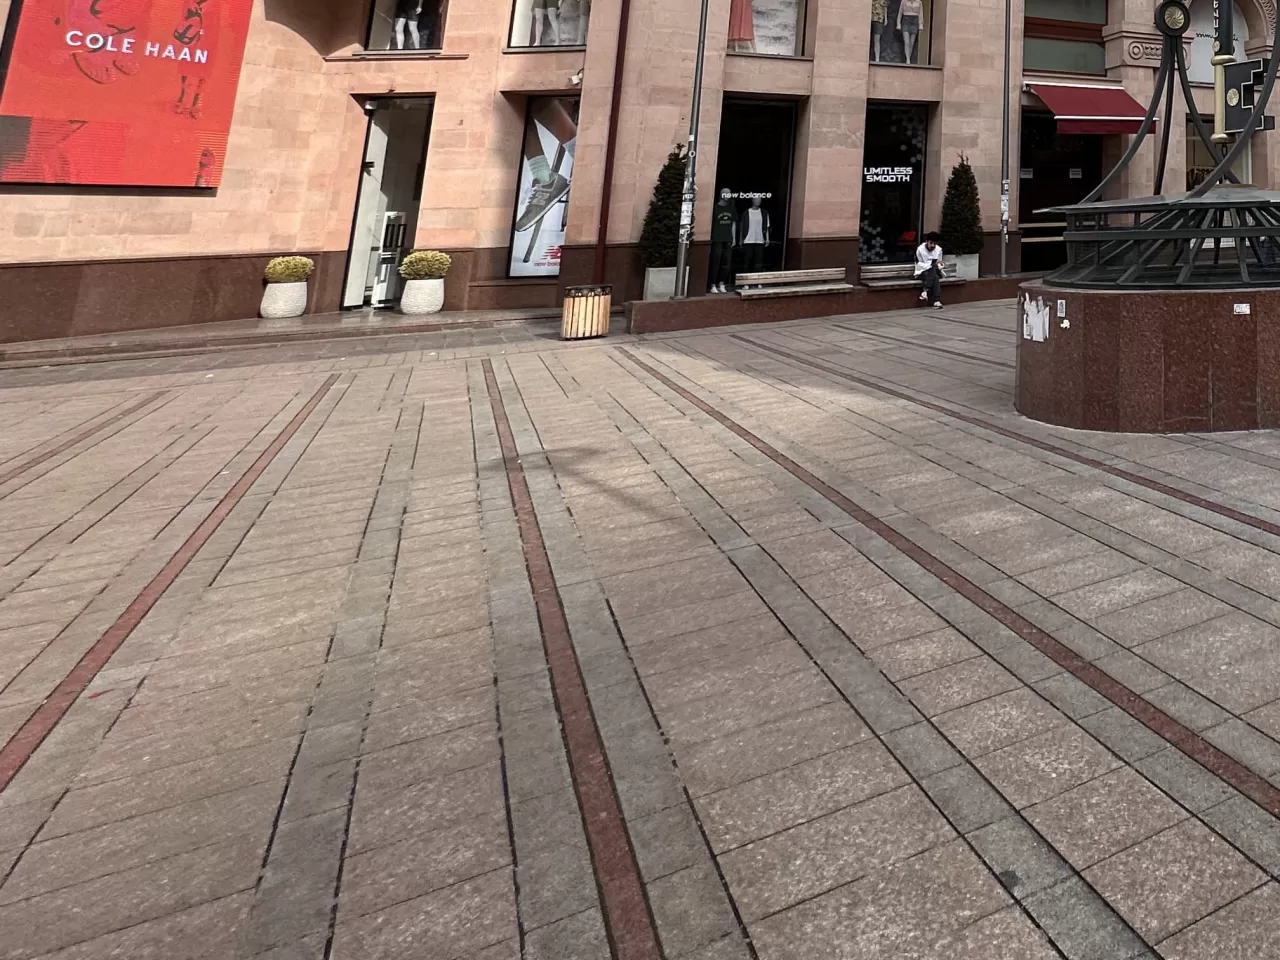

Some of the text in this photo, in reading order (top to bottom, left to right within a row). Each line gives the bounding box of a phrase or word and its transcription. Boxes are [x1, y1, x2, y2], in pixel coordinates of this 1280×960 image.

[65, 30, 208, 64] COLE HAAN
[864, 167, 913, 175] LIMITLESS
[740, 191, 772, 199] balance
